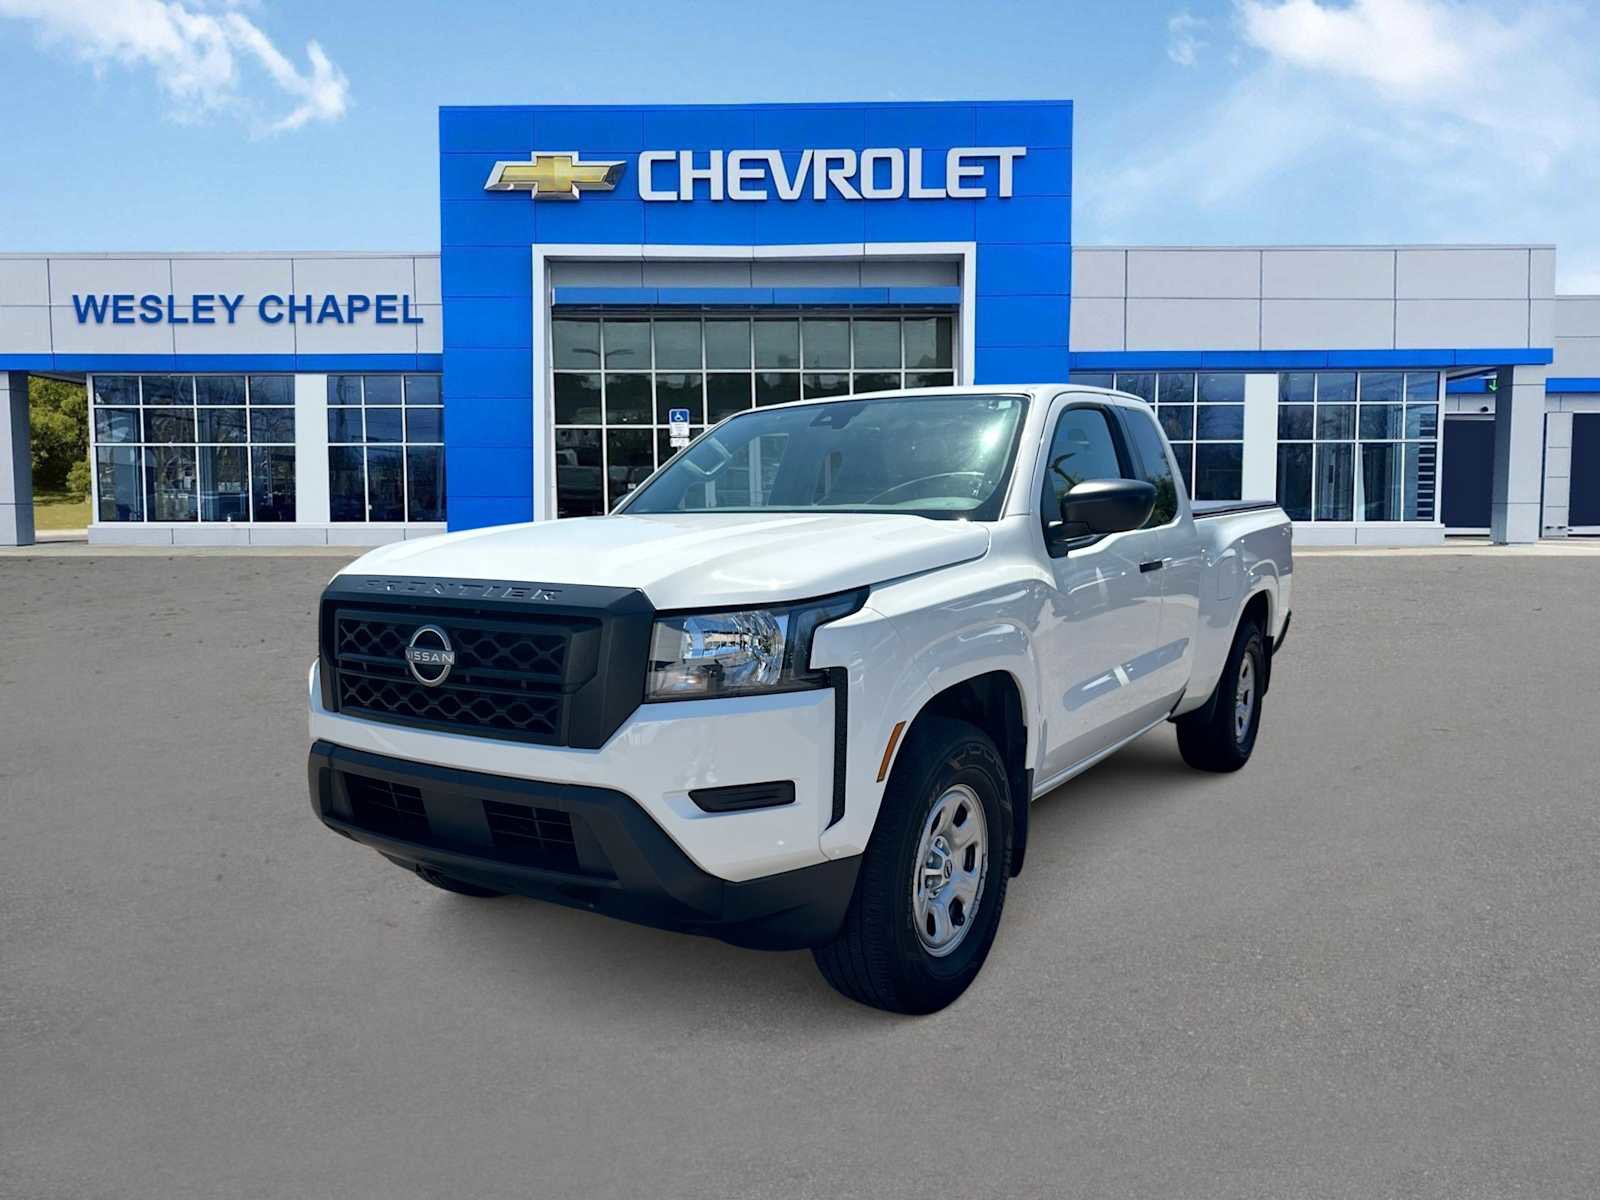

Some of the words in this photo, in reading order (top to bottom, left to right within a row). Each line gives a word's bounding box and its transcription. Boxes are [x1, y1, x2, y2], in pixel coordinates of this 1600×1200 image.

[638, 146, 1027, 202] CHEVROLET
[72, 294, 244, 325] WESLEY
[258, 293, 424, 325] CHAPEL
[405, 650, 454, 663] NISSAN
